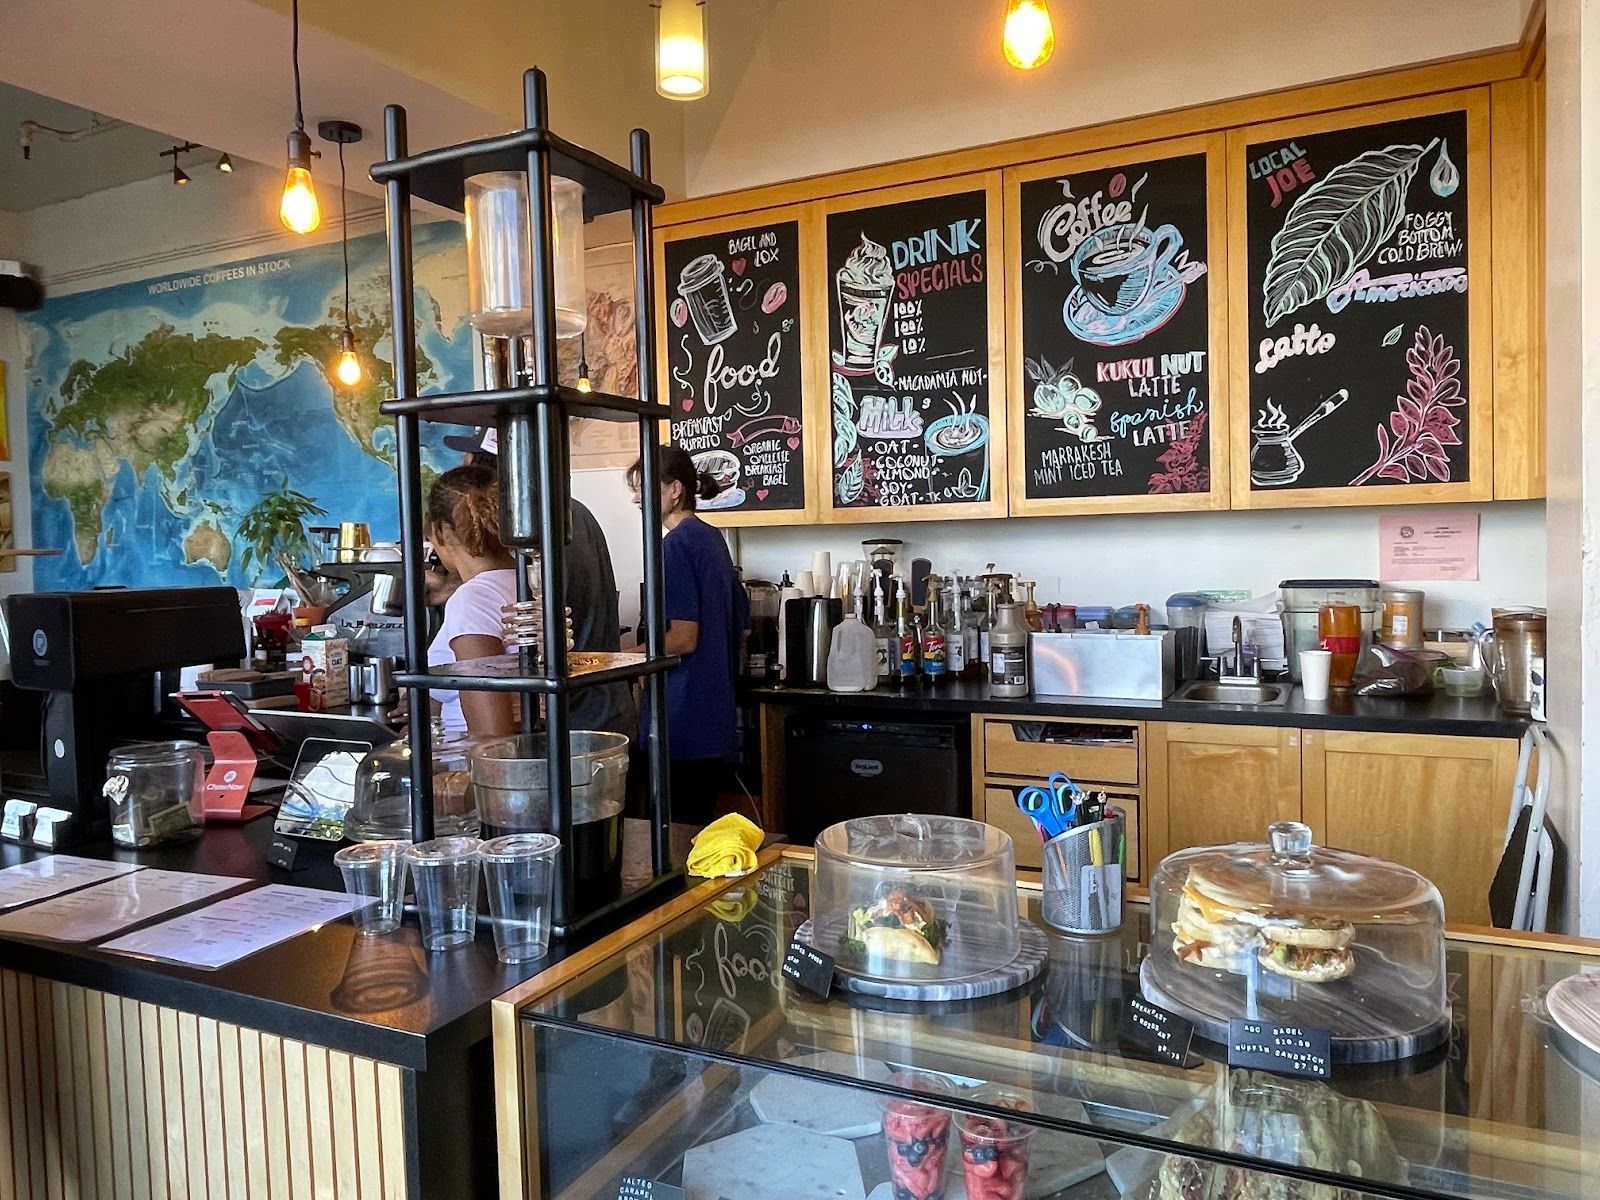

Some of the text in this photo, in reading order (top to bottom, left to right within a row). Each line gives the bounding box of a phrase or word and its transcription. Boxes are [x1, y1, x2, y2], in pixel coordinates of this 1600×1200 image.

[1249, 141, 1307, 180] LOCAL
[1266, 157, 1317, 209] JOE
[1037, 190, 1133, 262] Coffee
[1405, 211, 1453, 230] FOGGY
[728, 231, 777, 255] BAGEL AND
[891, 218, 982, 271] DRINK
[1398, 226, 1454, 246] BOTTOM
[754, 247, 779, 267] LOX
[1377, 247, 1413, 265] COLD
[147, 258, 291, 295] WORLDWIDE COFFEES IN STOCK
[896, 253, 983, 300] SPECIALS
[1327, 268, 1468, 314] Americano
[893, 299, 922, 319] 100%
[894, 317, 923, 337] 100%
[902, 337, 926, 355] 10%
[704, 331, 782, 414] food
[1096, 351, 1206, 383] KUKUI NUT
[898, 368, 982, 391] MACADAMIA NUT
[1128, 375, 1182, 398] LATTE
[672, 415, 724, 440] BREAKFAST
[1133, 420, 1192, 447] LATTE
[680, 434, 720, 451] BURRITO
[743, 440, 781, 456] ORGANIC
[875, 440, 910, 454] OAT
[876, 455, 938, 469] COCONUT
[1041, 442, 1112, 468] MARRAKESH
[745, 463, 787, 476] BREAKFAST
[877, 467, 930, 480] ALMOND
[1033, 459, 1123, 486] MINT ICED TEA
[763, 474, 788, 486] BAGEL
[880, 481, 907, 495] SOY
[880, 492, 919, 506] GOAT
[207, 783, 246, 791] ChowNow
[1131, 999, 1167, 1023] BREAKFAST
[1244, 1025, 1303, 1036] ABC BAGEL
[1235, 1044, 1324, 1065] MUFFIN SANDWICH
